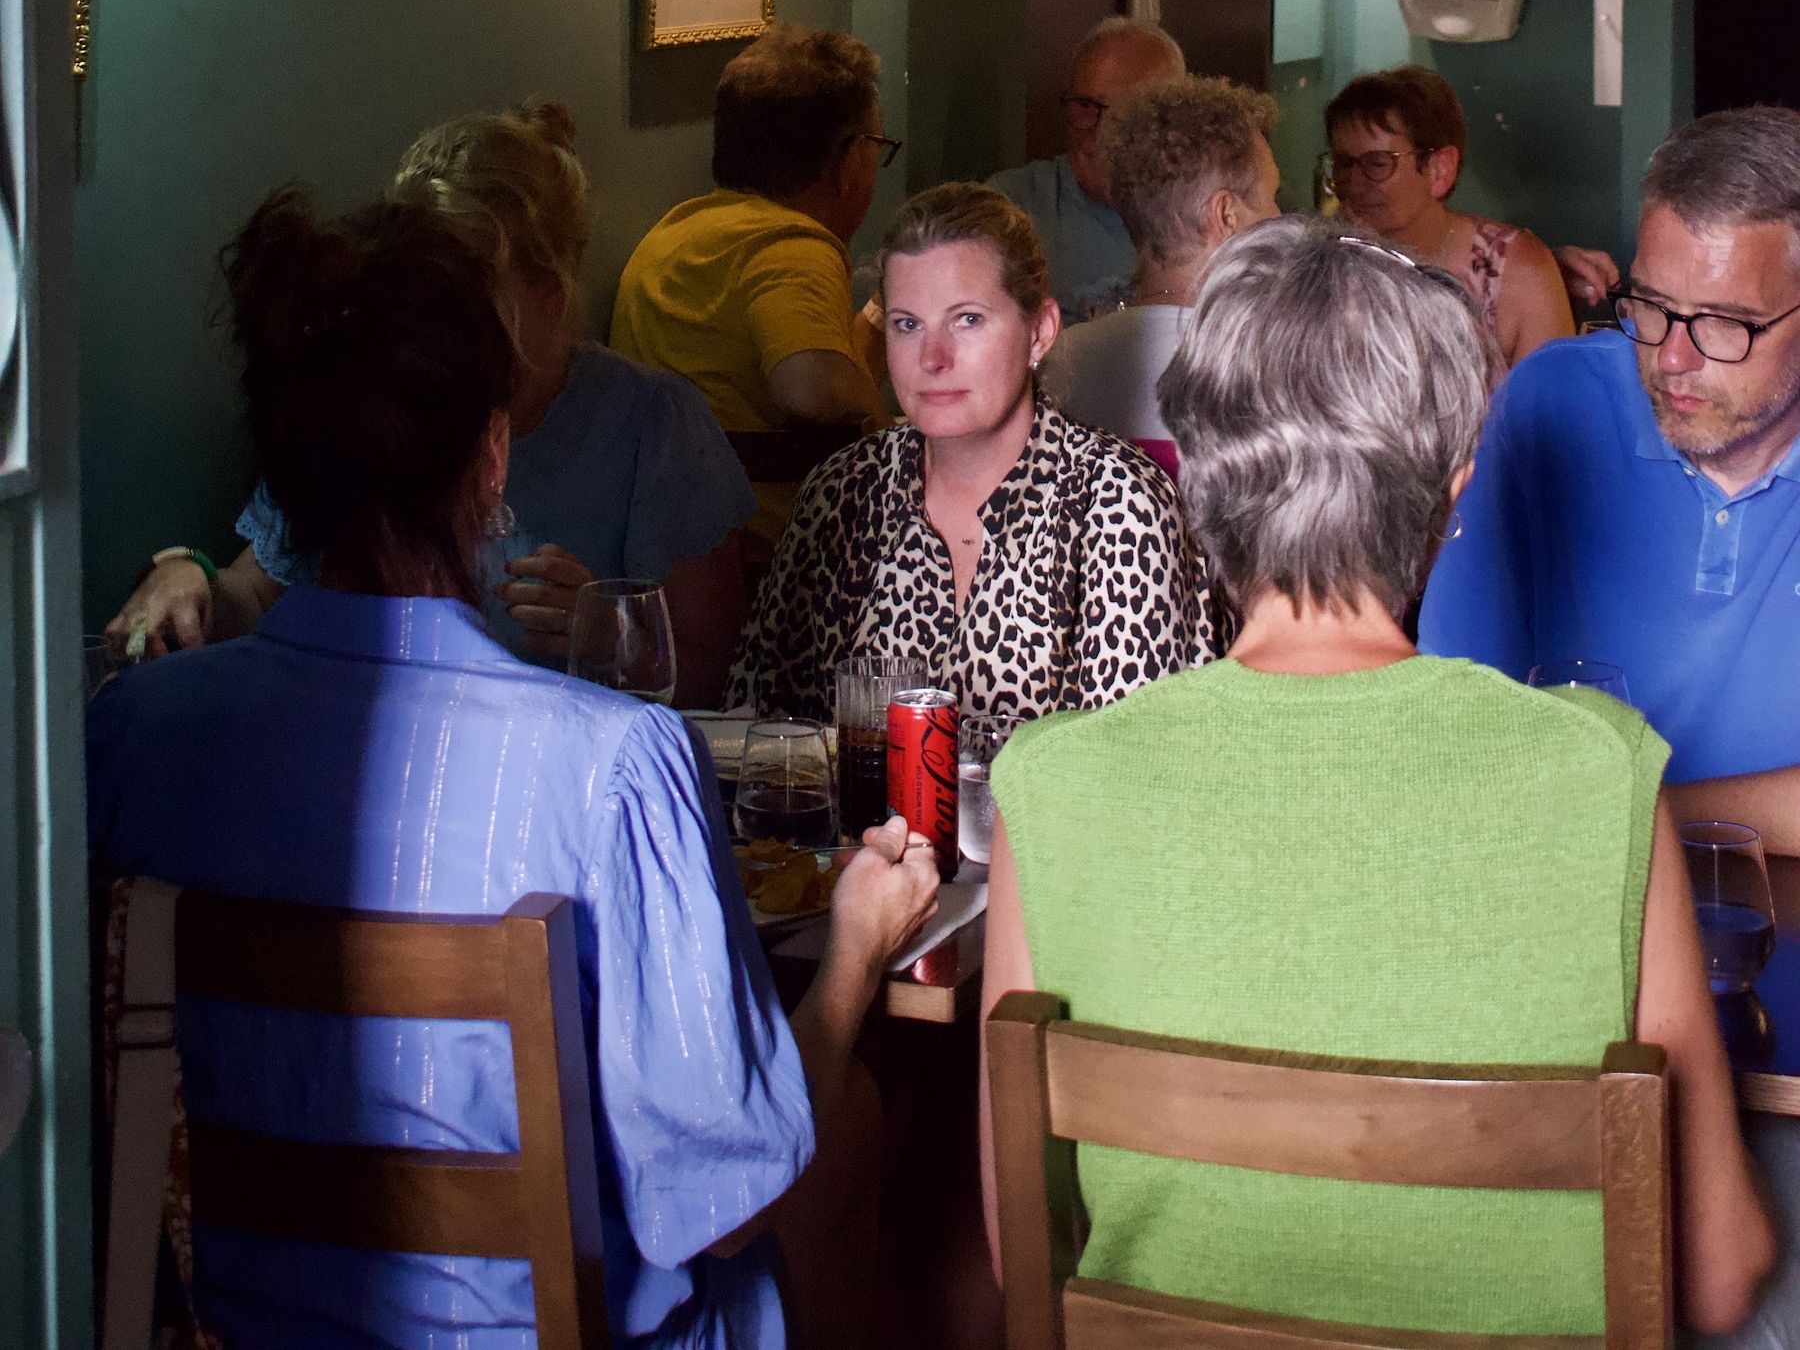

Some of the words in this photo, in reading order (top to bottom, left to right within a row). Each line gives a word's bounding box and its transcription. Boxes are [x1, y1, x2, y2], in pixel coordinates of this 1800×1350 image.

[915, 764, 923, 780] CUP
[920, 706, 958, 862] oca-Cola
[915, 781, 923, 808] WORLD
